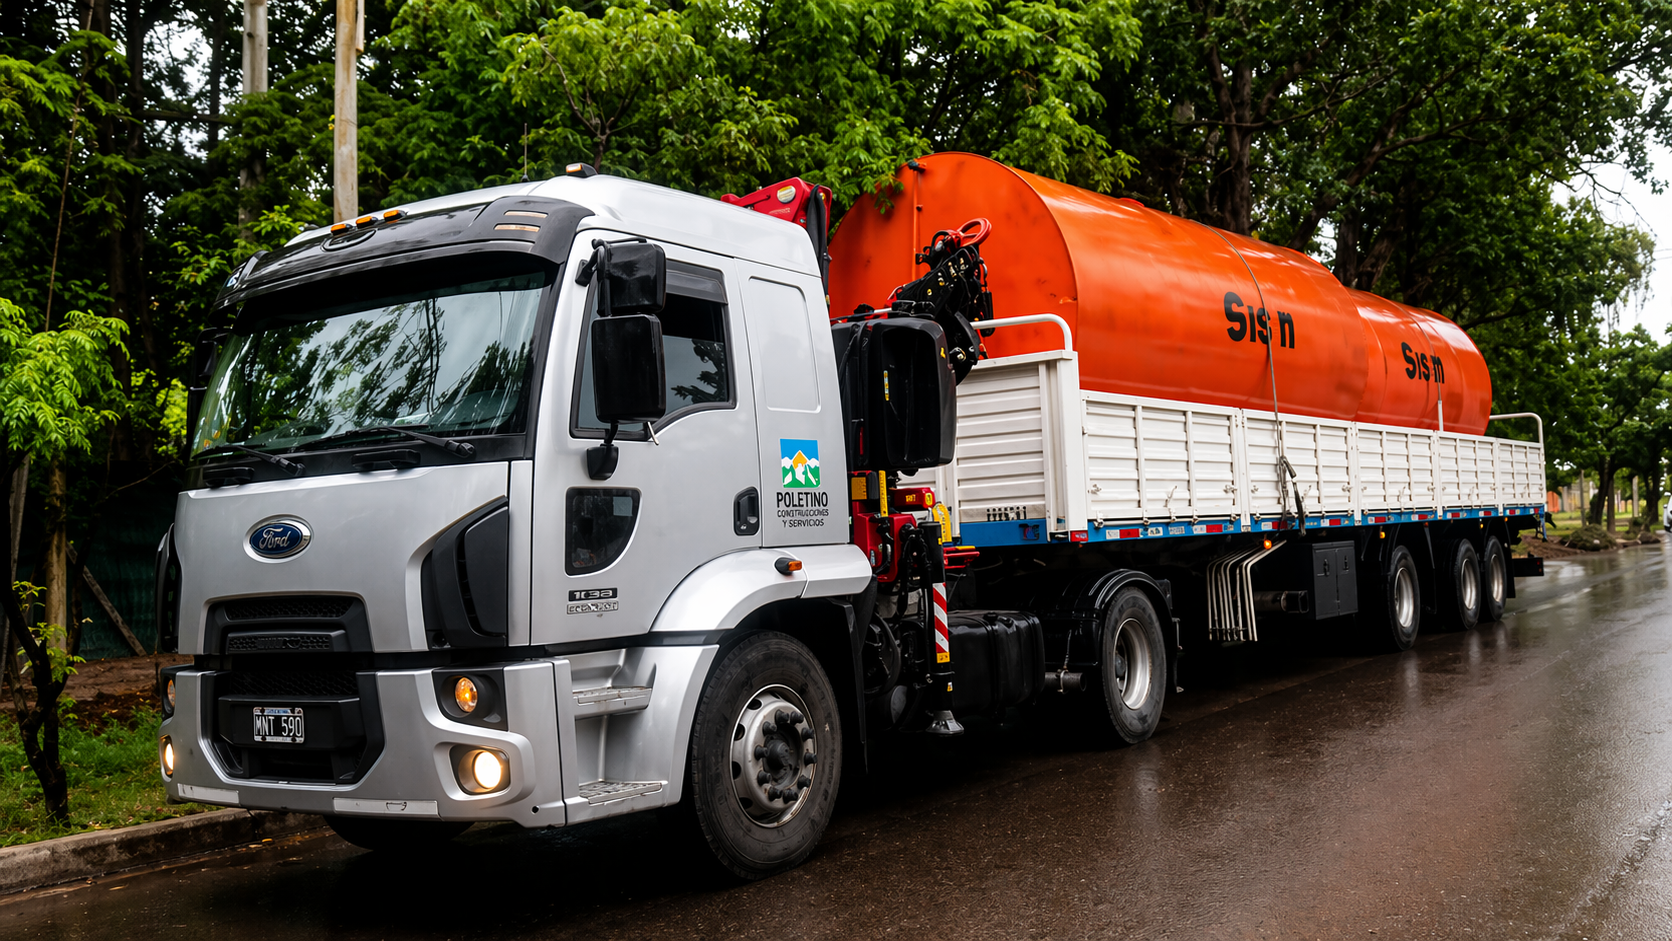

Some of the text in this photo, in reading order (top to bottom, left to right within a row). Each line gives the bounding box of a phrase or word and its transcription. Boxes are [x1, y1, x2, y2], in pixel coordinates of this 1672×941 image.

[776, 491, 829, 508] POLETINO
[782, 518, 825, 528] Y SERVICIOS
[259, 527, 292, 549] Ford
[255, 715, 302, 737] MNT 590
